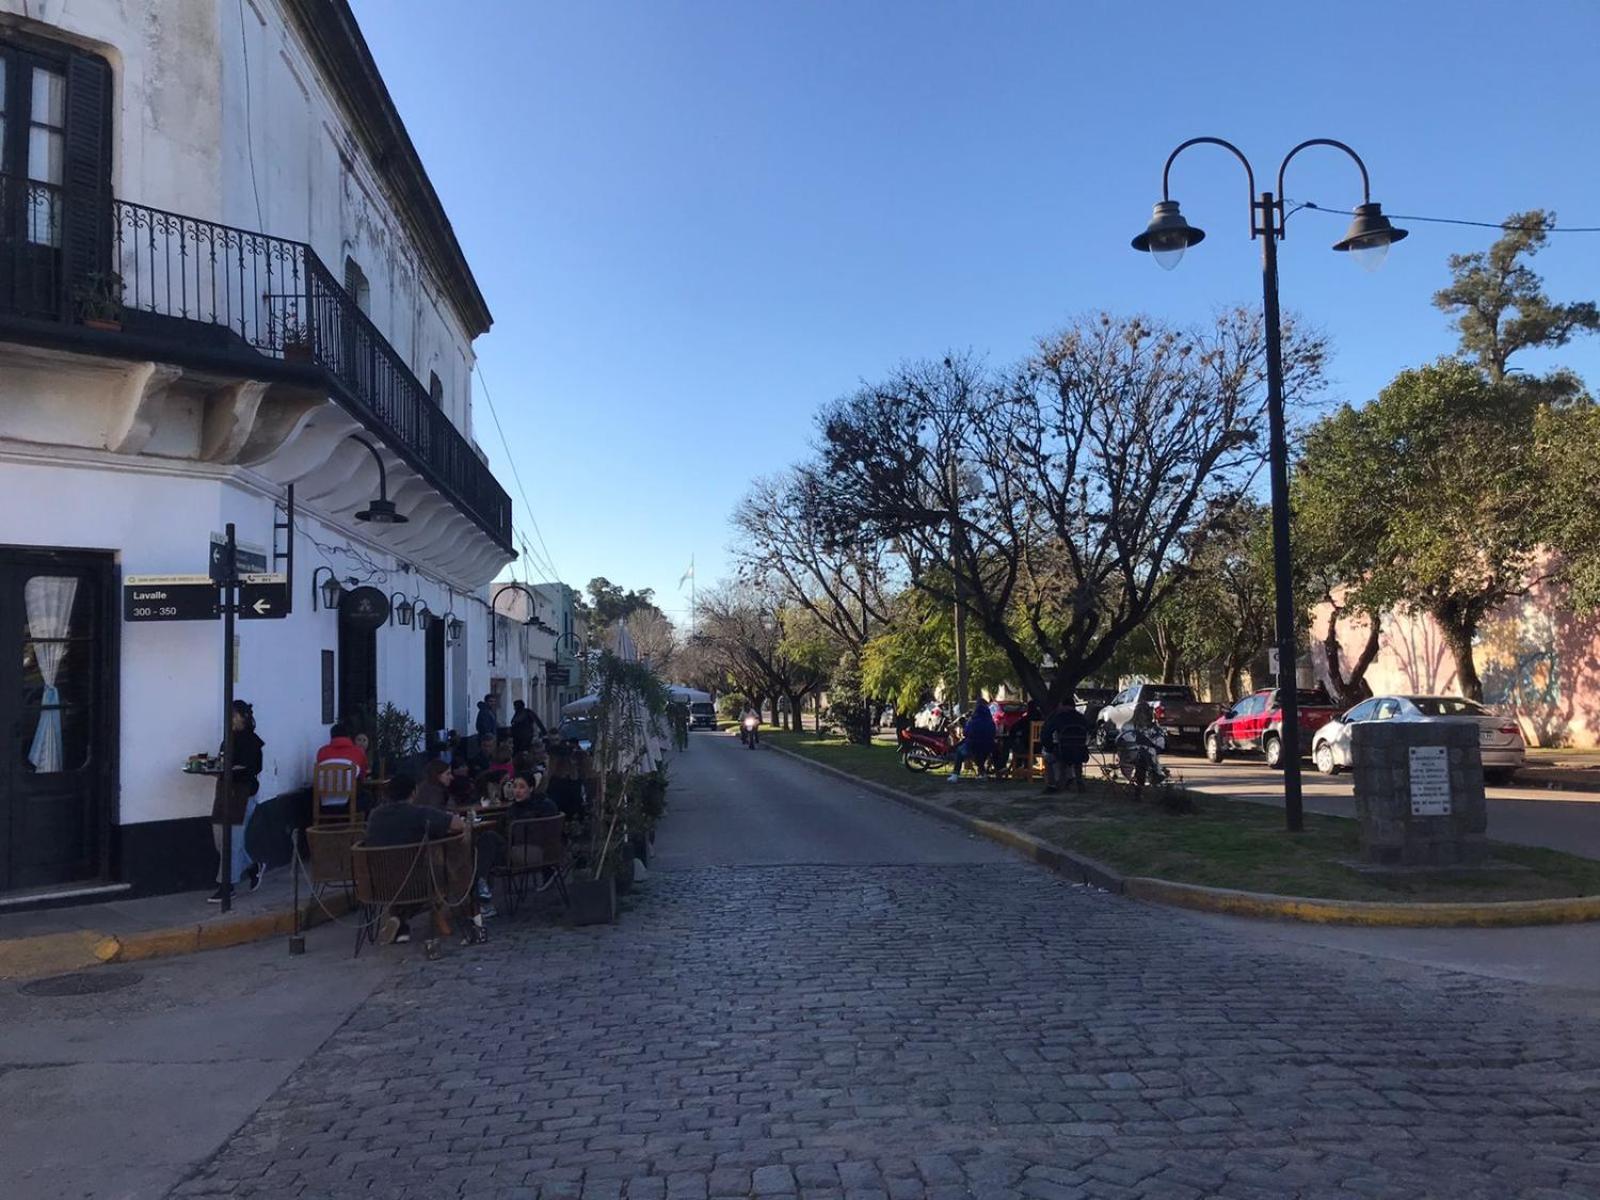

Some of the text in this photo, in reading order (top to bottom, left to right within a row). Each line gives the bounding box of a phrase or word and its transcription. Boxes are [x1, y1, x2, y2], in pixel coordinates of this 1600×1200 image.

[133, 591, 167, 600] Lavalle
[133, 607, 151, 617] 300
[159, 607, 177, 616] 350
